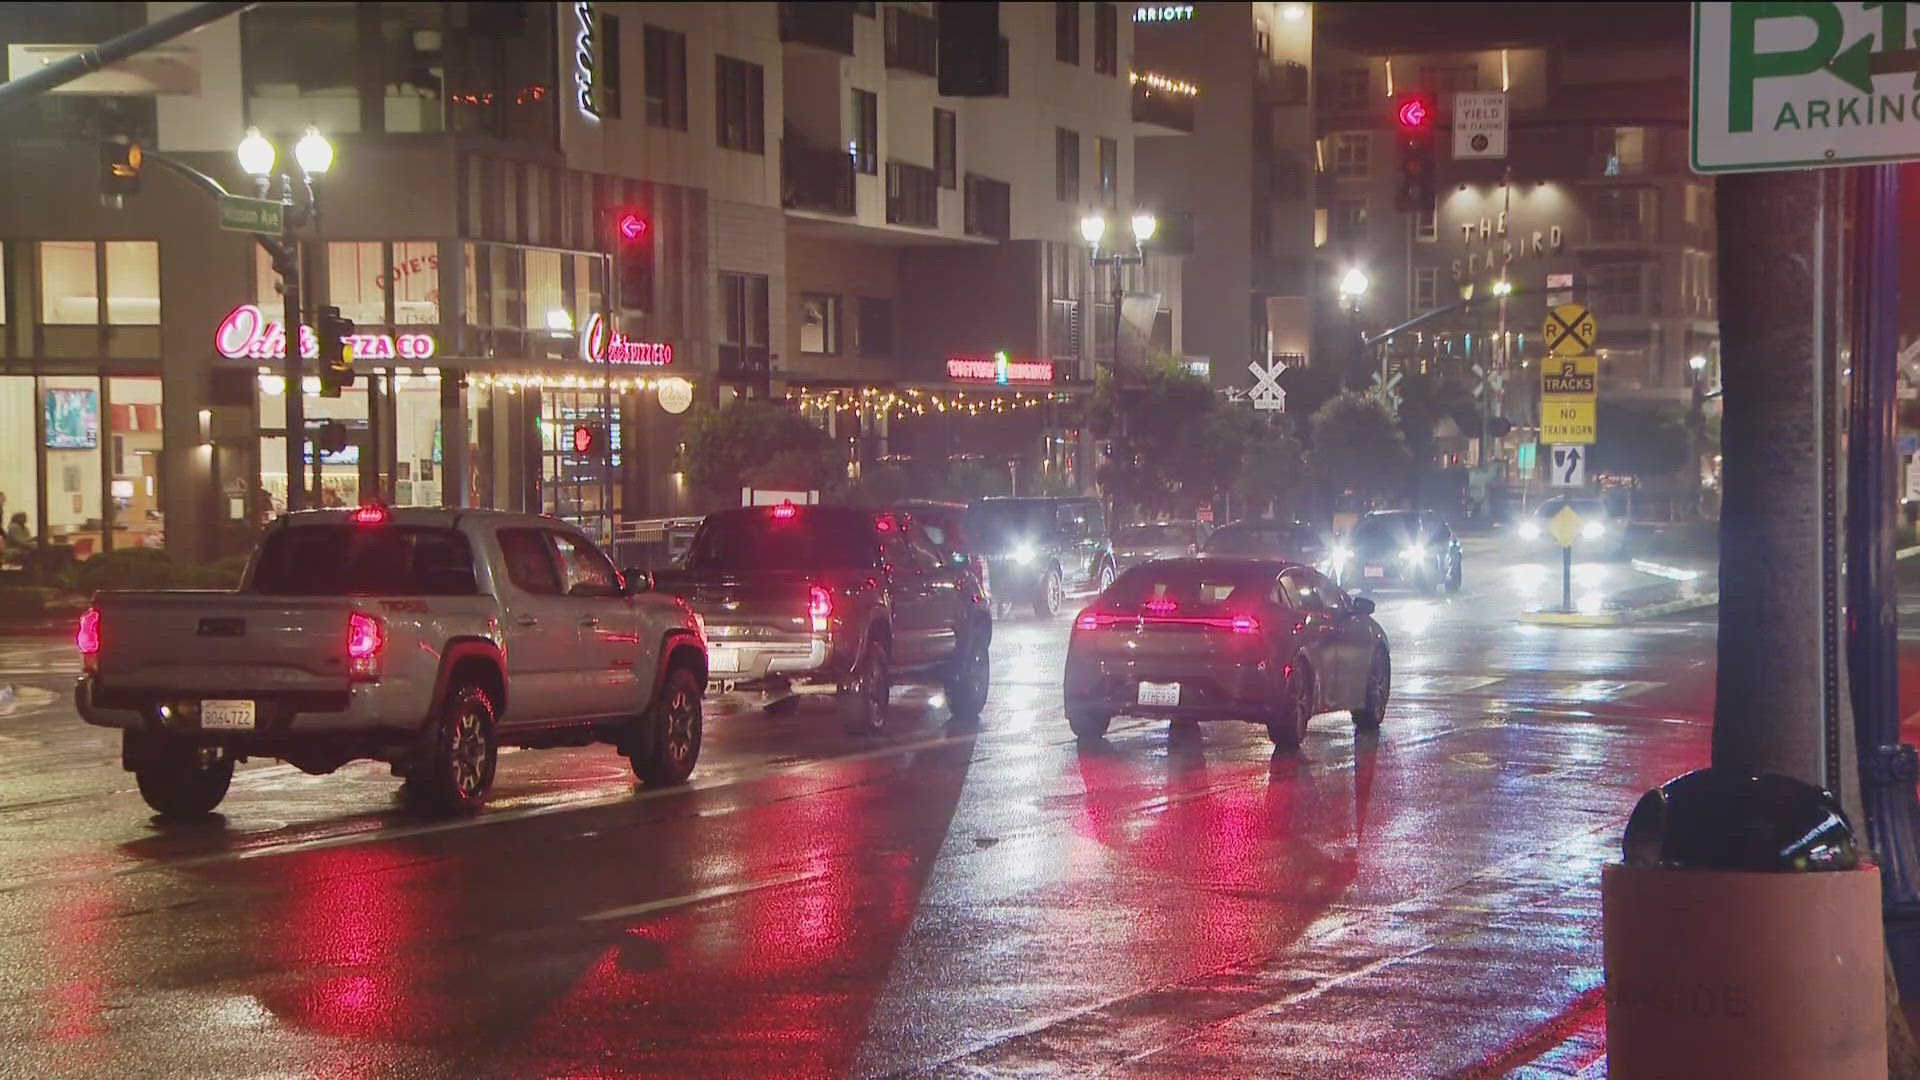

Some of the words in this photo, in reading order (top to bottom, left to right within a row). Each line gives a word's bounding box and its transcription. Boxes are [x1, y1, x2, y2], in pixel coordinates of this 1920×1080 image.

[1132, 6, 1194, 22] RRIOTT
[1464, 108, 1498, 119] YIELD
[1461, 210, 1506, 243] THE
[1451, 225, 1561, 279] SEABIRD
[341, 334, 395, 359] ZZA
[396, 334, 434, 359] CO
[1564, 365, 1573, 378] 2
[1546, 379, 1592, 390] TRACKS
[1560, 409, 1577, 420] NO
[1544, 425, 1567, 435] TRAIN
[1570, 425, 1592, 435] HORN
